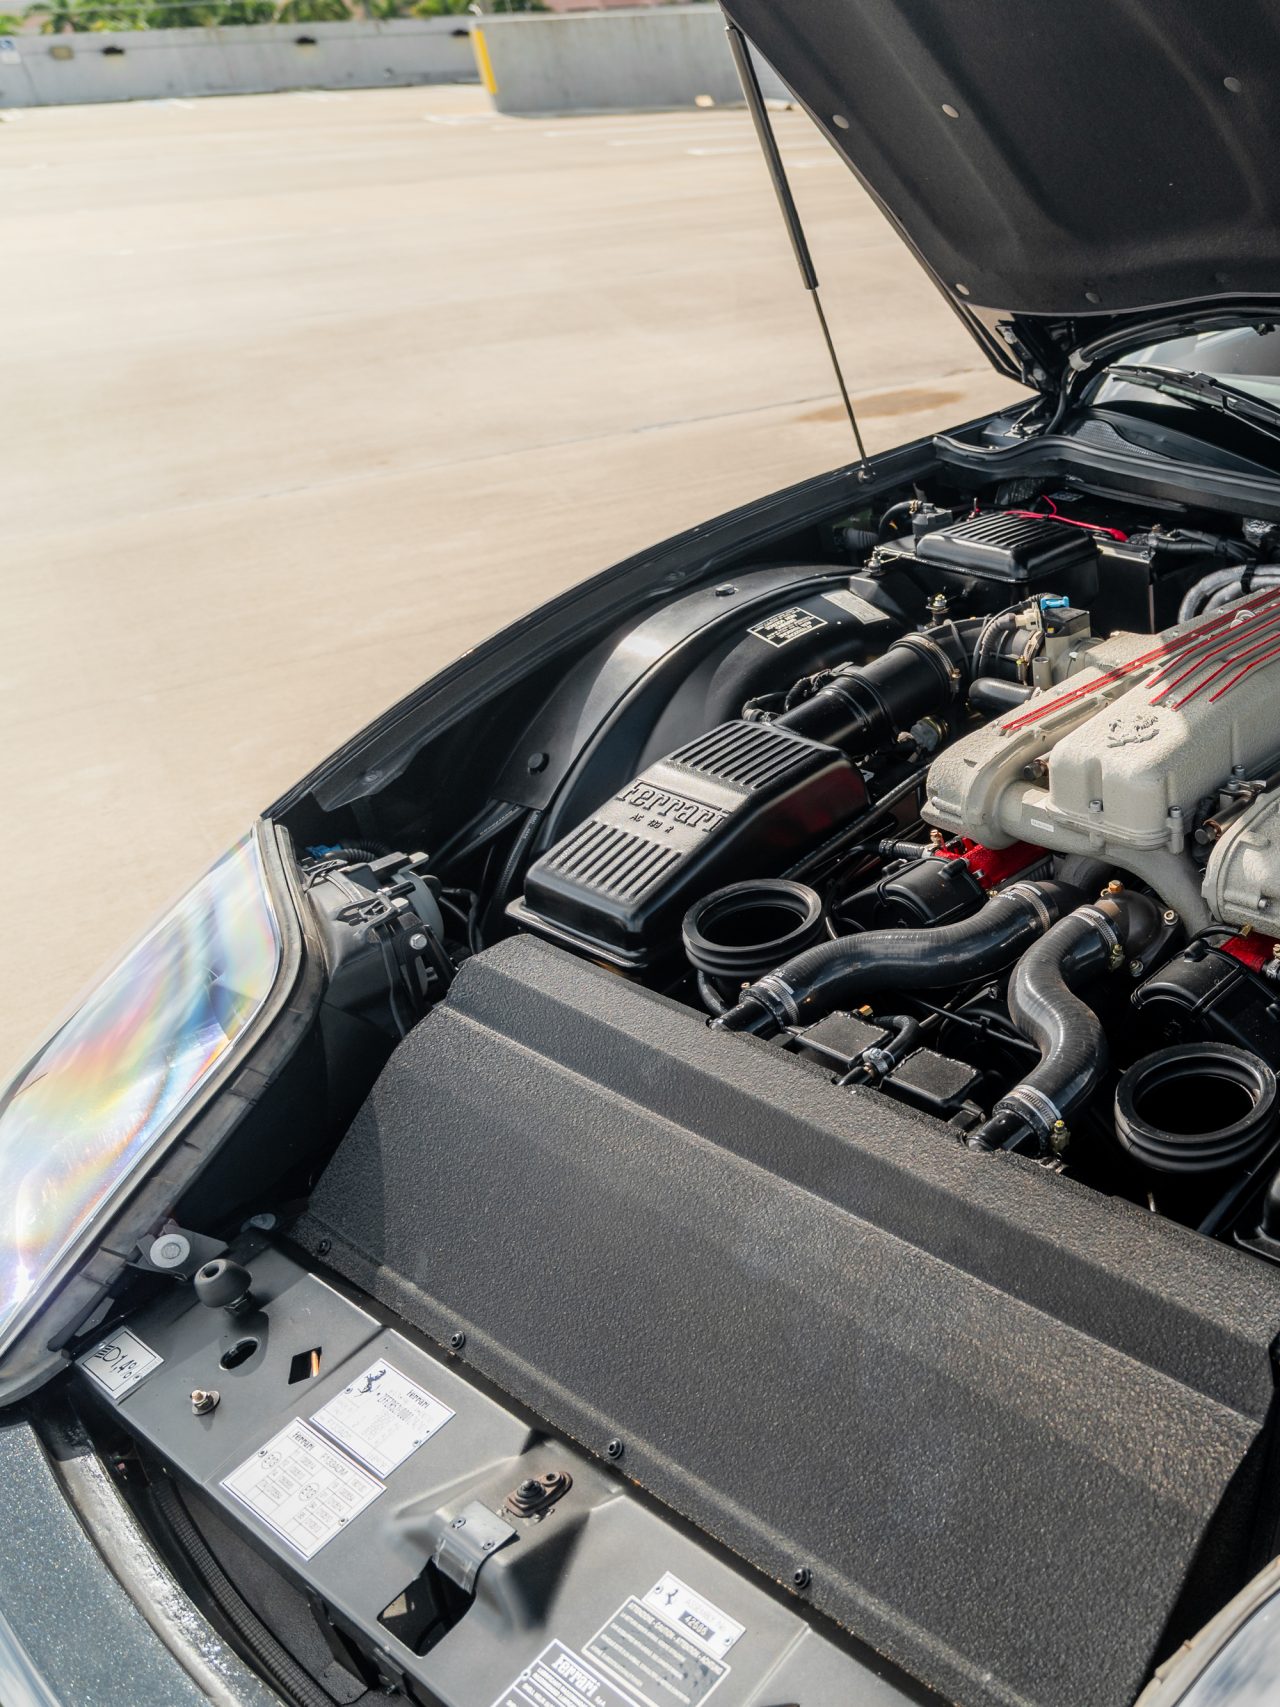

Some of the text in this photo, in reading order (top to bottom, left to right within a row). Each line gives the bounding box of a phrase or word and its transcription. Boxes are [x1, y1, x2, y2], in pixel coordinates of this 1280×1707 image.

[615, 778, 732, 832] Ferrari
[406, 1389, 430, 1409] Ferrari
[292, 1430, 315, 1451] Ferrari
[551, 1653, 600, 1698] Ferrari
